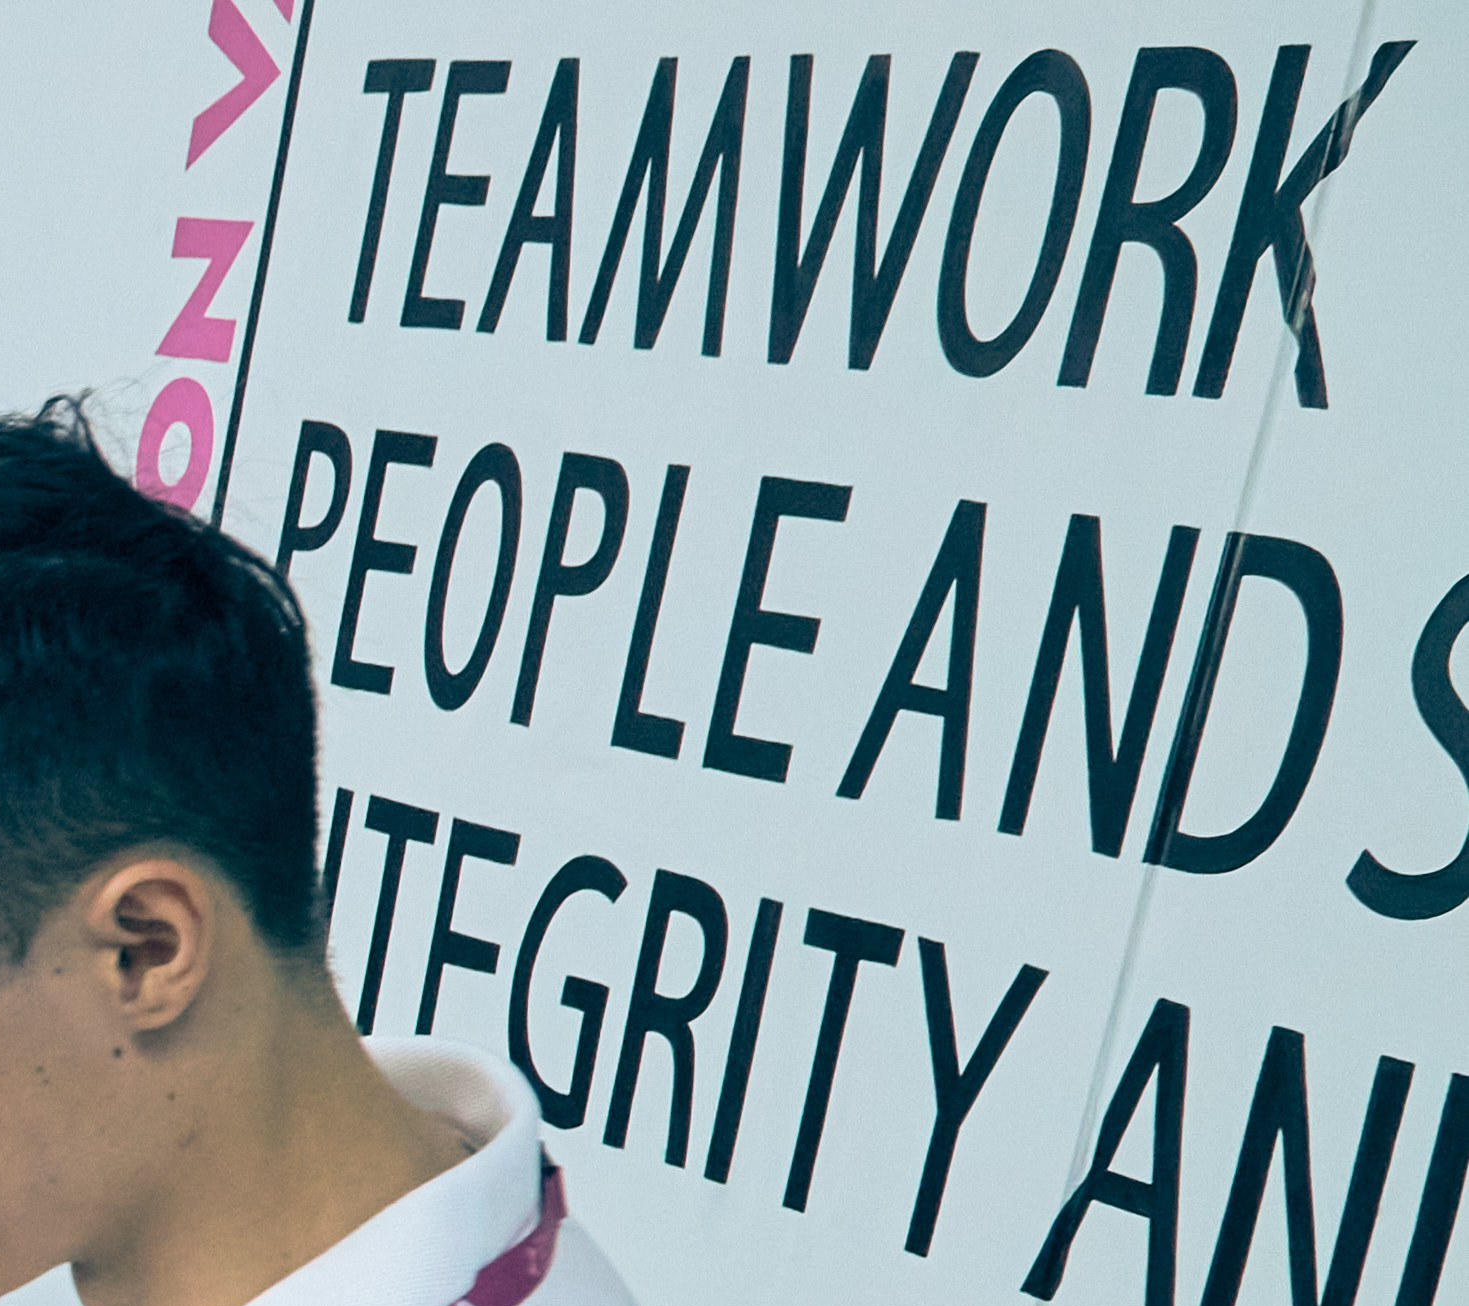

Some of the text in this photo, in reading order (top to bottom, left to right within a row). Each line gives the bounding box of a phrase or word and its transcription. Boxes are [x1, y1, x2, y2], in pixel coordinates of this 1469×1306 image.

[348, 41, 1417, 409] TEAMWORK
[277, 420, 852, 783] PEOPLE
[836, 500, 1343, 874] AND
[324, 789, 1048, 1257] TEGRITY
